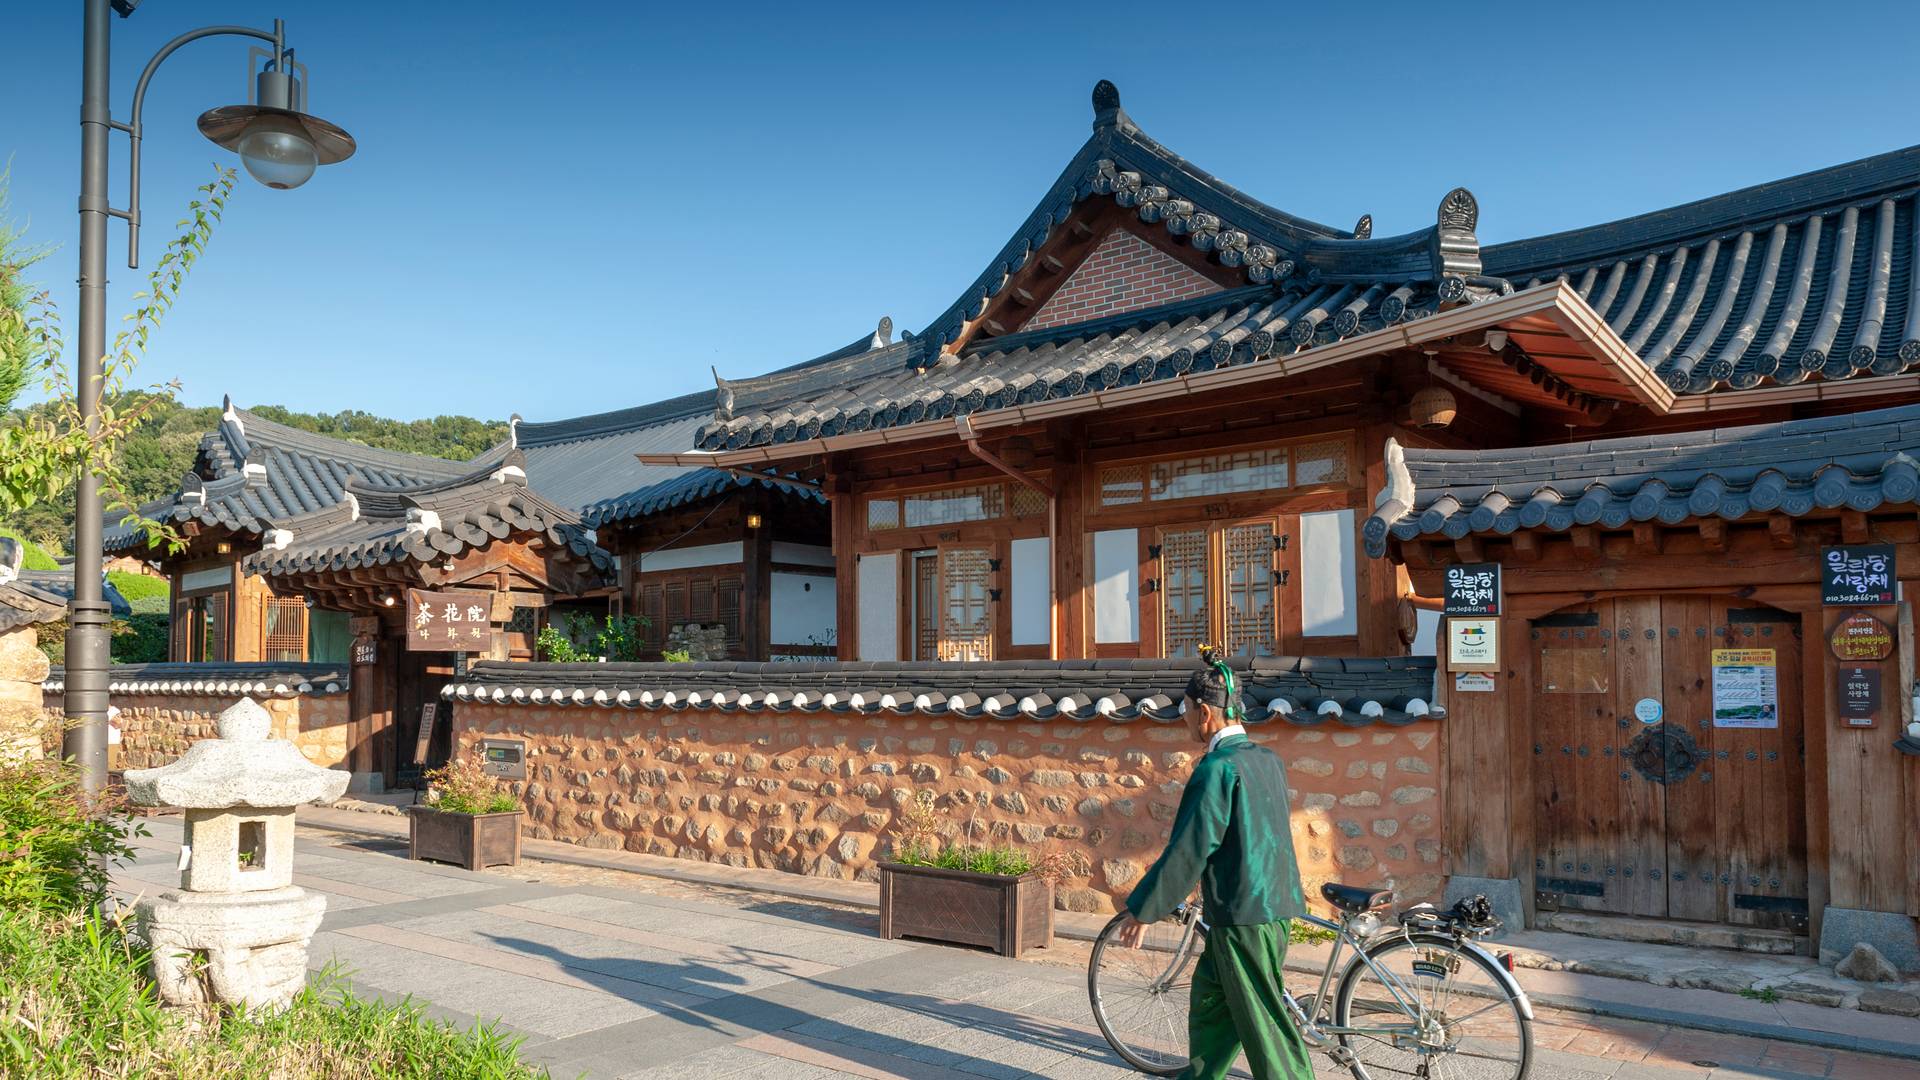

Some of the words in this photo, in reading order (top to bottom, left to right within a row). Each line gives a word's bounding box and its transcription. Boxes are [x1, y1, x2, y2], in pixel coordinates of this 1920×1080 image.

[1828, 550, 1889, 576] 일락당
[1448, 568, 1495, 590] 일락당
[1832, 573, 1888, 593] 사랑채
[1451, 588, 1493, 605] 사랑채
[415, 602, 486, 625] 茶花院
